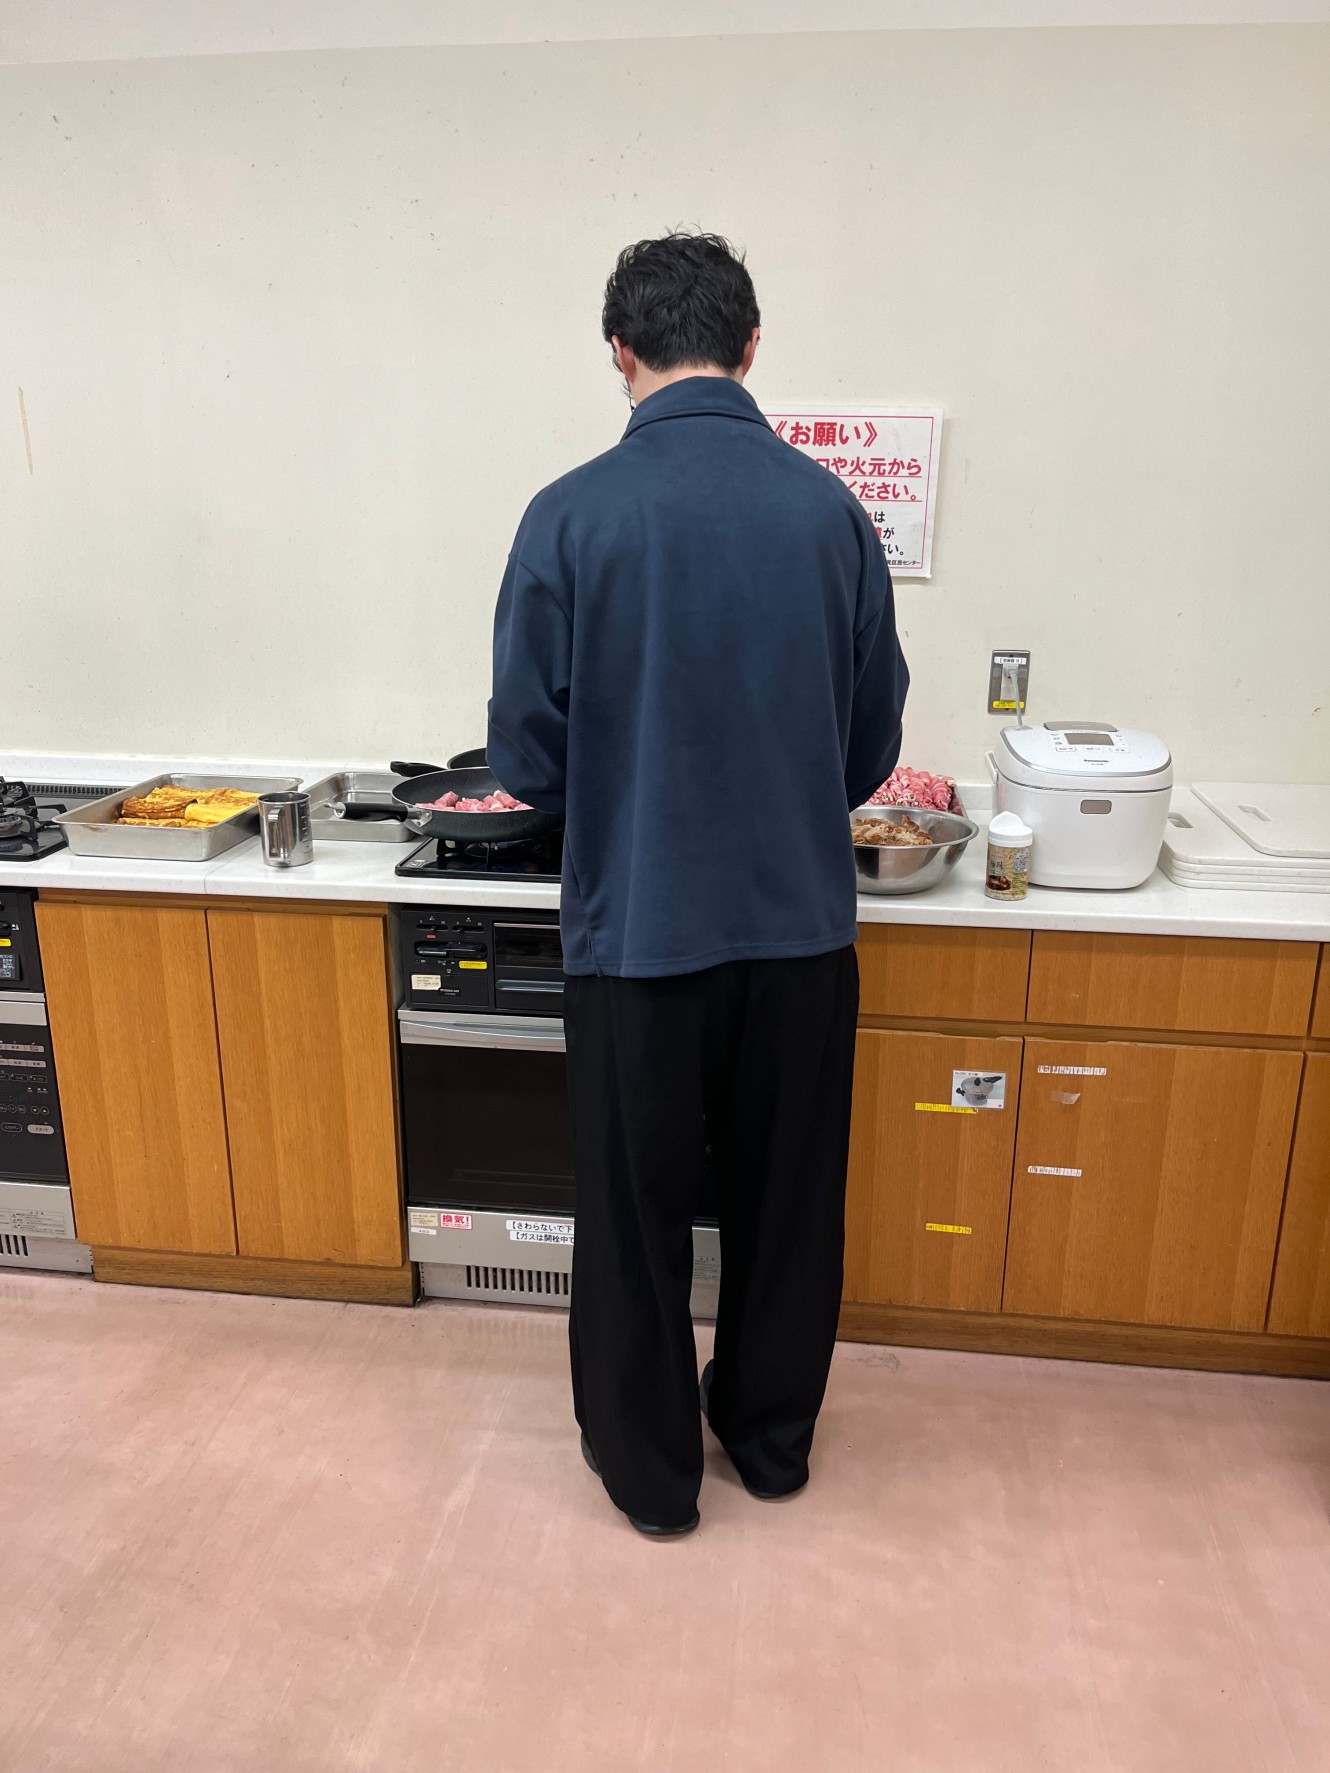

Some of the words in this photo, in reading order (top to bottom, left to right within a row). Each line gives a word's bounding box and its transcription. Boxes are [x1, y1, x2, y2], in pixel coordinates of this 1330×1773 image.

[774, 420, 878, 447] 《お願い》
[512, 1221, 573, 1233] 【さわらないで下
